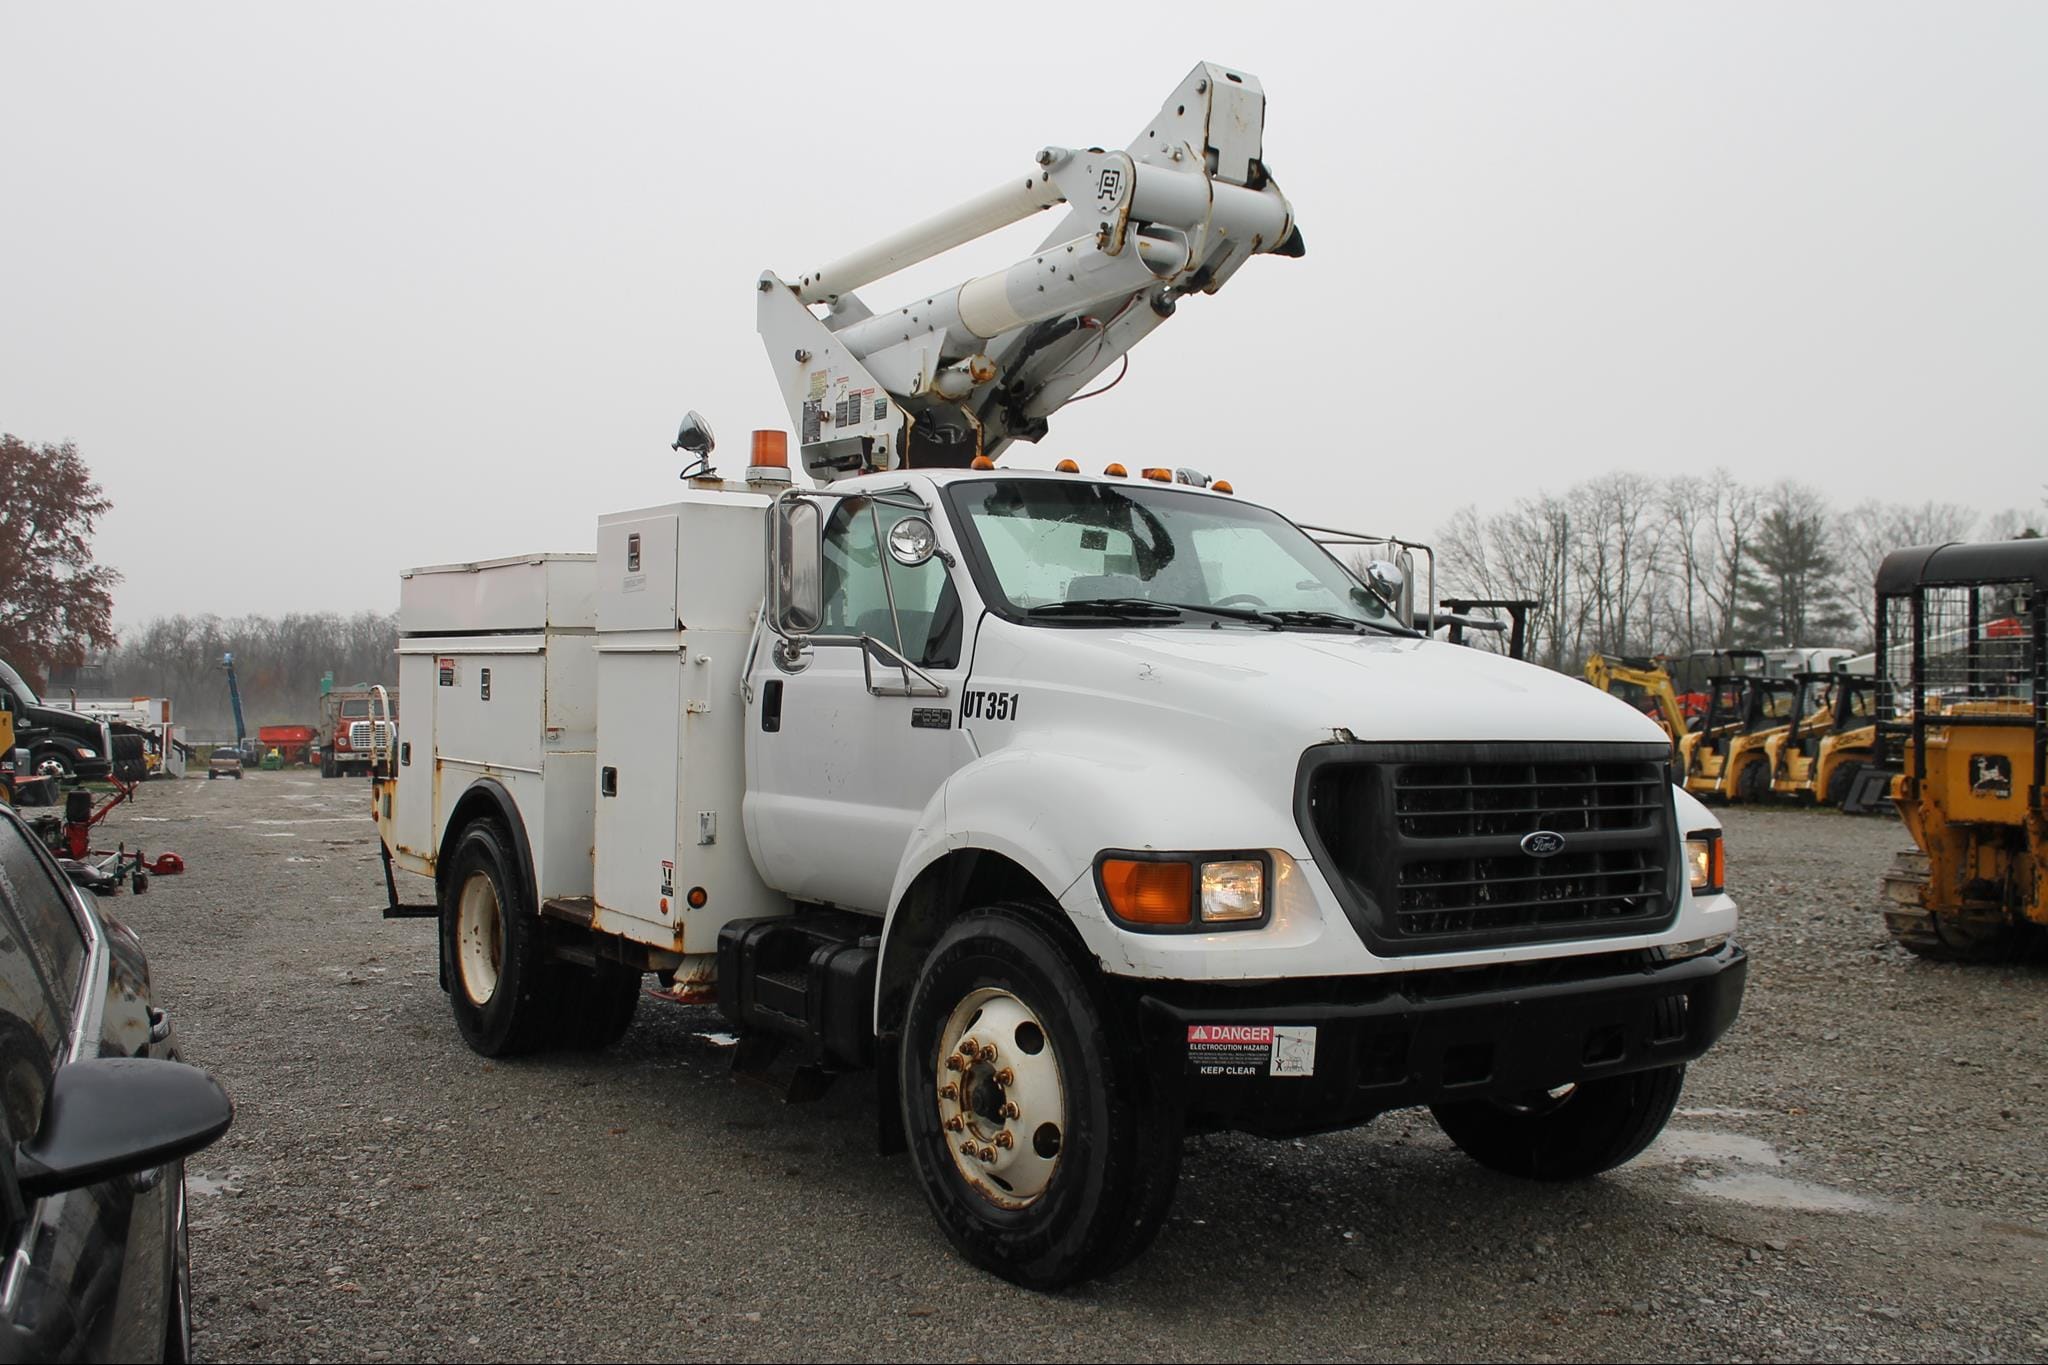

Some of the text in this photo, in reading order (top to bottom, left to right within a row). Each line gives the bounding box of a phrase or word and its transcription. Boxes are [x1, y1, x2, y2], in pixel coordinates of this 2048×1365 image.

[963, 690, 1019, 721] UT 351
[1532, 836, 1557, 852] Ford
[1211, 1026, 1270, 1041] DANGER
[1200, 1066, 1256, 1075] KEEP CLEAR
